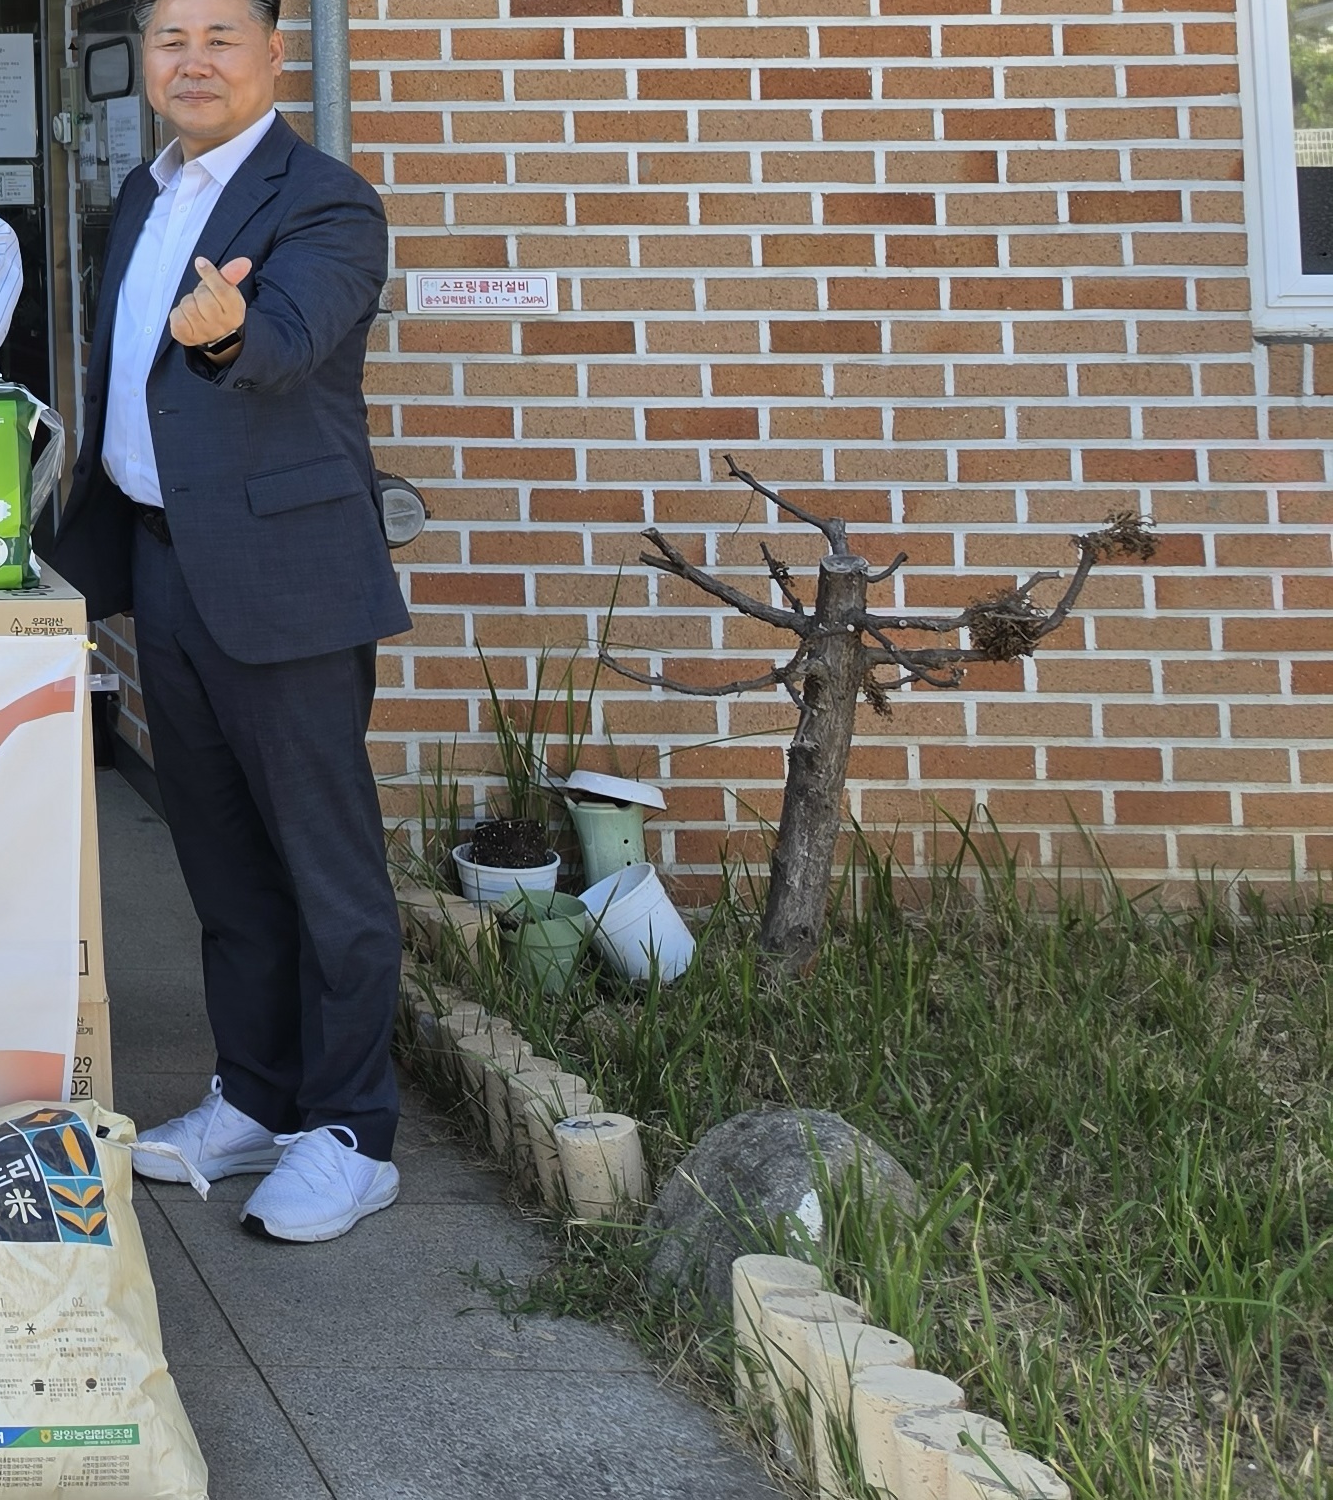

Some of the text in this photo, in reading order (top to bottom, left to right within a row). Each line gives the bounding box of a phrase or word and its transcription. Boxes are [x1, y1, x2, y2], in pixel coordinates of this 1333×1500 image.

[439, 280, 529, 293] 스프링클러설비
[485, 296, 498, 304] 0.1
[3, 1188, 42, 1224] 米
[72, 1297, 84, 1308] 02
